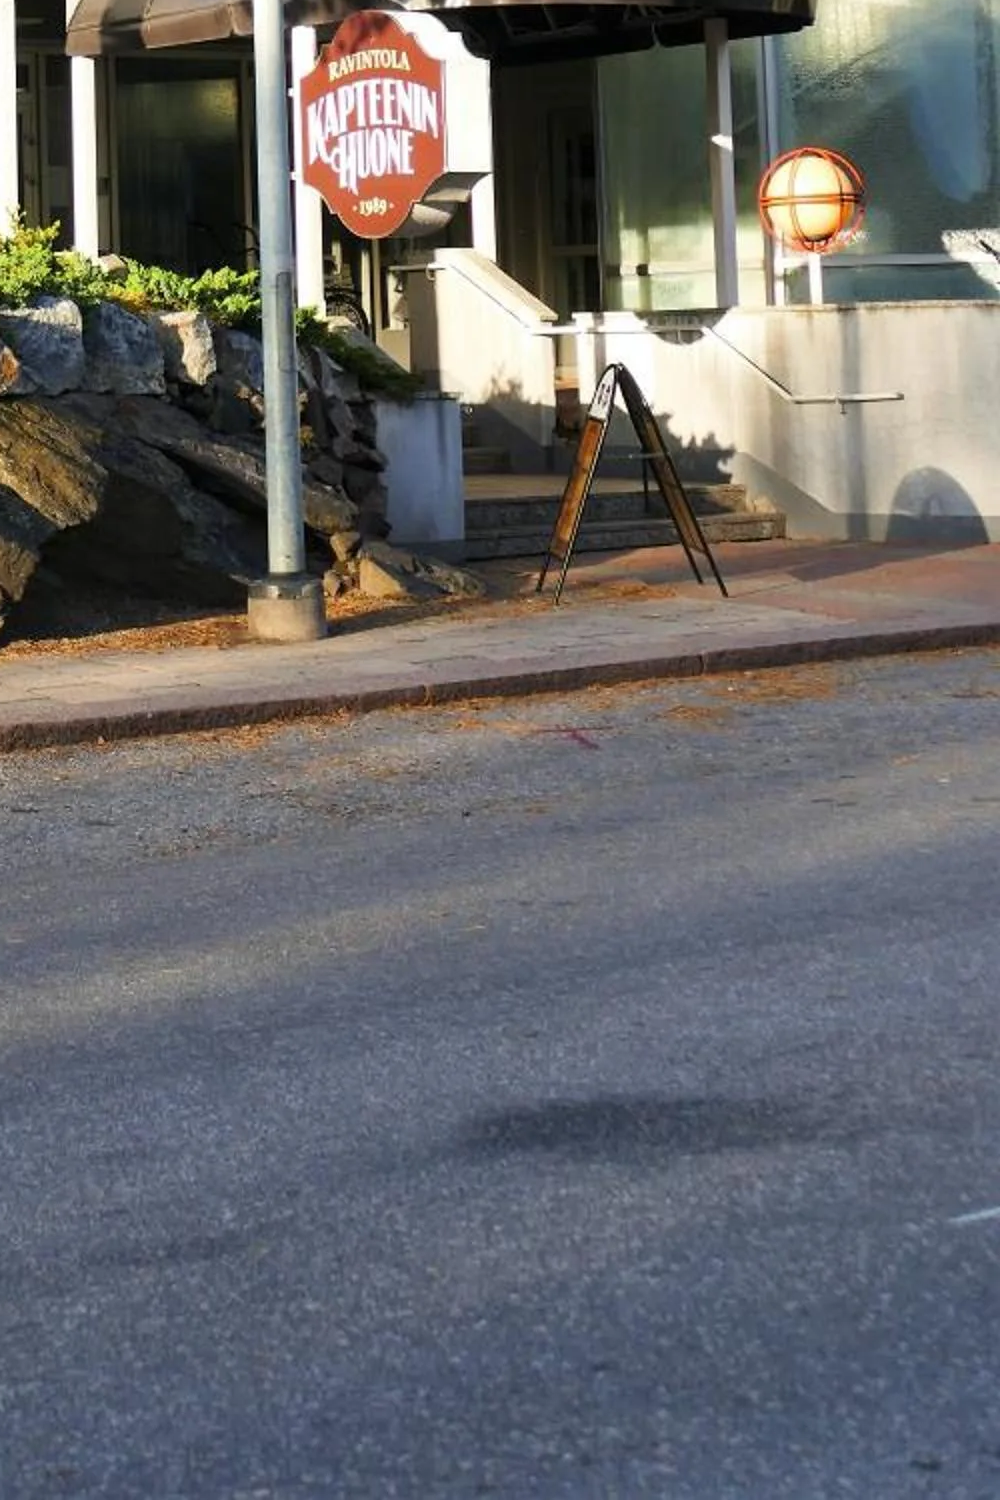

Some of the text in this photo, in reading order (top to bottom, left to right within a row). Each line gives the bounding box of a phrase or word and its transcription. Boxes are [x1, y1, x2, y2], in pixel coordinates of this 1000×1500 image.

[328, 49, 411, 82] RAVINTOLA
[307, 77, 439, 165] KAPTEENIN
[330, 127, 415, 196] HUONE
